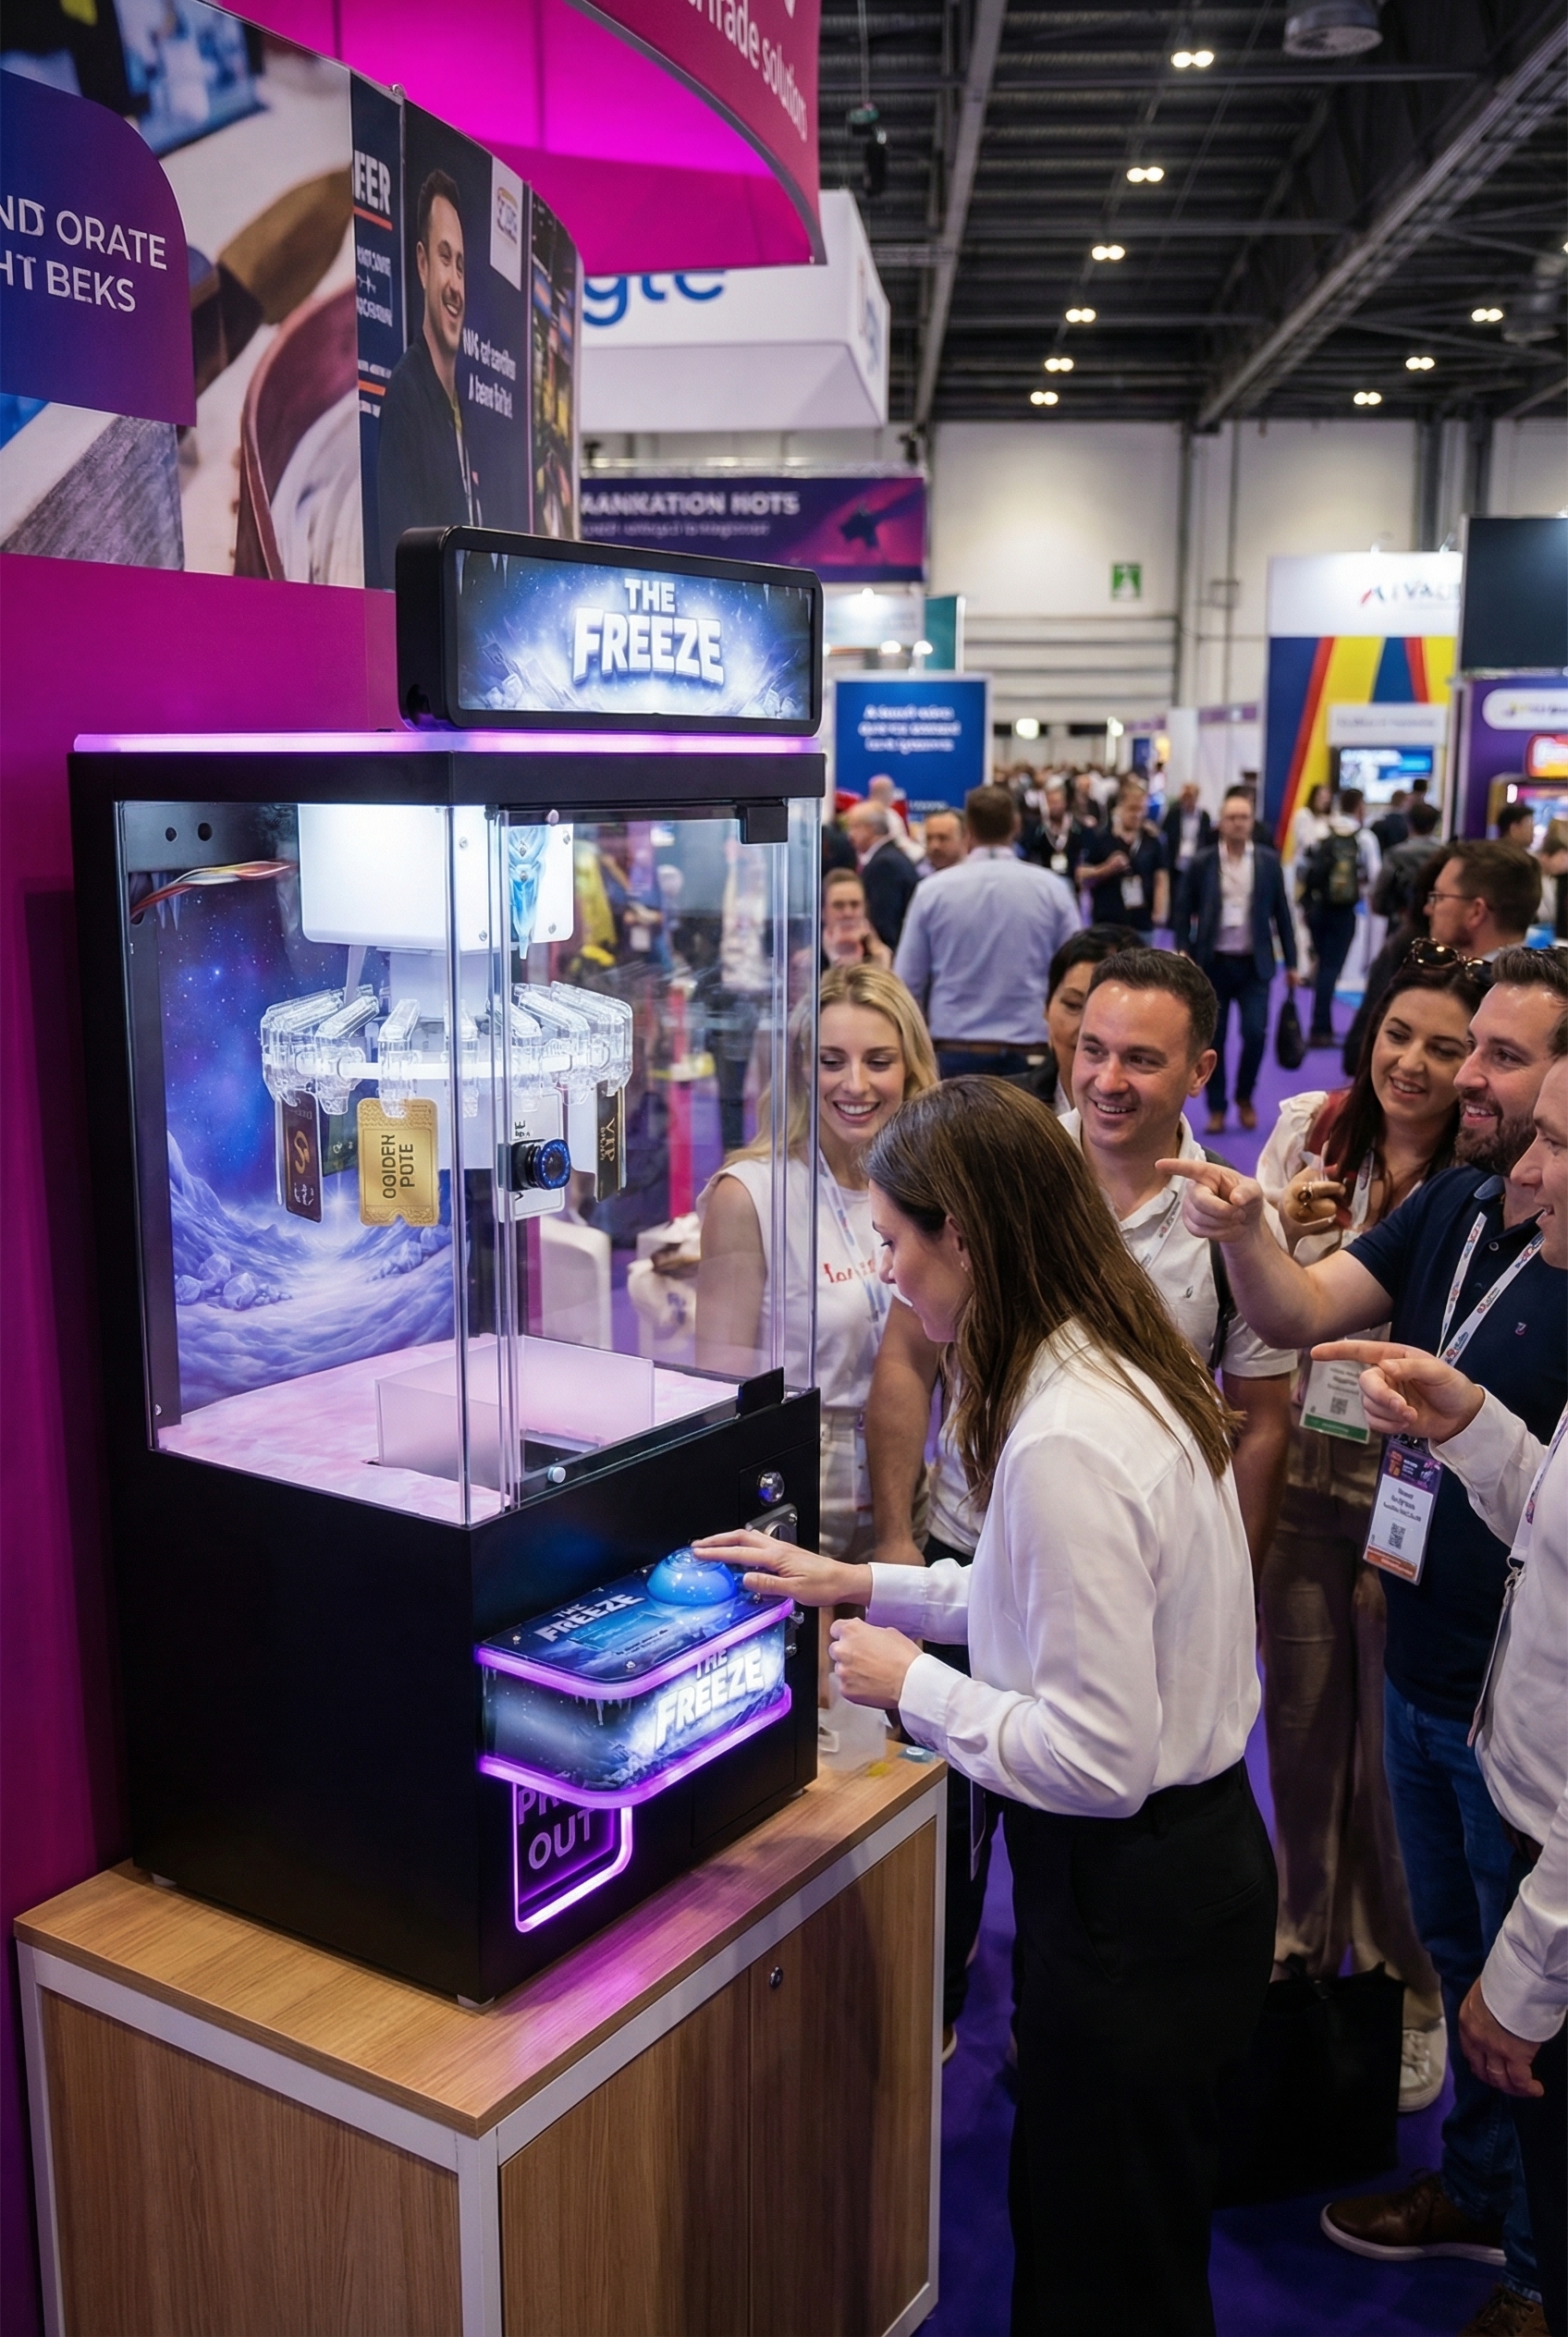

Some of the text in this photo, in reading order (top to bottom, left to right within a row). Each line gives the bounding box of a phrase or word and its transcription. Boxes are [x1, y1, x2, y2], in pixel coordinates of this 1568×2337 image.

[55, 210, 167, 271] ORATE
[46, 260, 136, 312] BEKS
[624, 578, 676, 613] THE
[573, 607, 724, 685] FREEZE
[533, 1594, 645, 1642] FREEZE
[552, 1604, 587, 1618] THE
[655, 1646, 766, 1751] FREEZE
[528, 1808, 595, 1869] OUT
